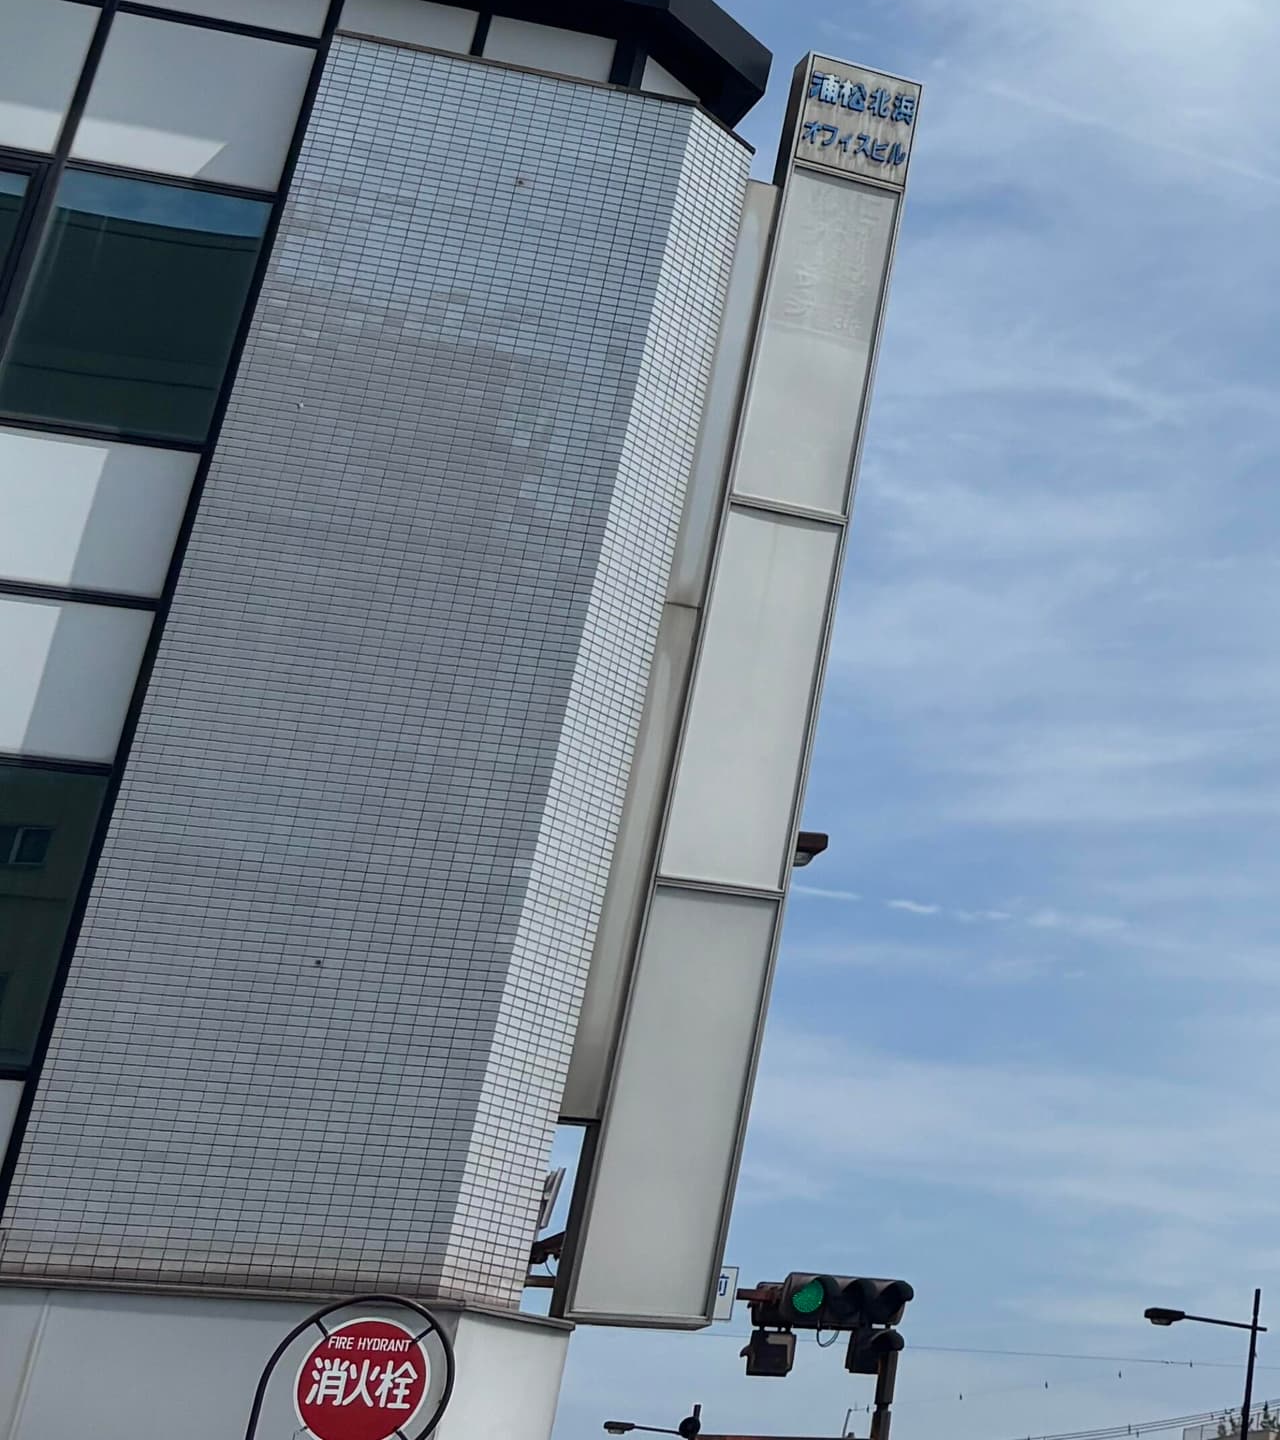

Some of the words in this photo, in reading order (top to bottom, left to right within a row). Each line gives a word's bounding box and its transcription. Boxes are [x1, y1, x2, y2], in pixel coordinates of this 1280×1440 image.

[328, 1336, 354, 1350] FIRE
[357, 1337, 412, 1353] HYDRANT
[305, 1357, 418, 1410] 消火栓
